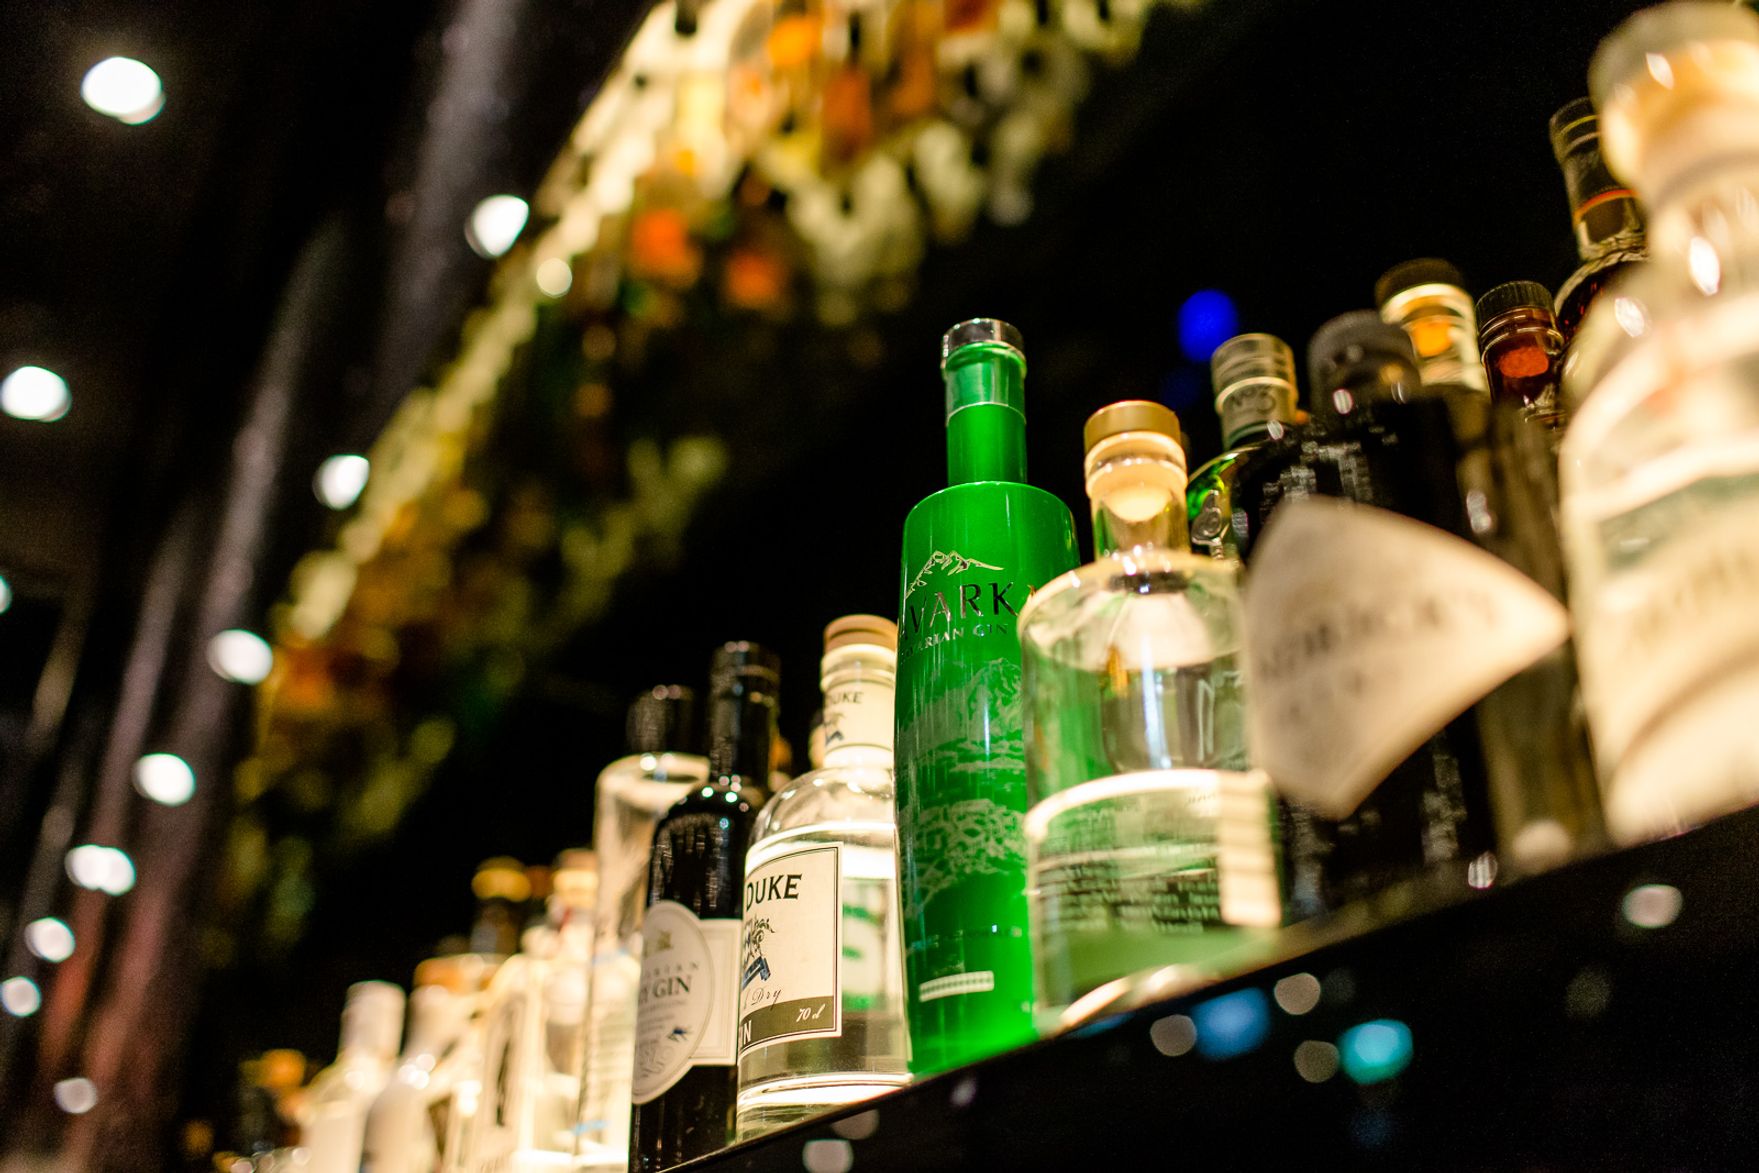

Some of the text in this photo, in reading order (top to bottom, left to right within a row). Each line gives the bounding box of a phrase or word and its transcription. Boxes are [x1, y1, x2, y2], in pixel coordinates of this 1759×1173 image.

[905, 582, 1036, 638] VARK
[746, 874, 803, 912] DUKE
[653, 975, 693, 998] GIN
[751, 987, 782, 1012] Dry
[796, 1007, 812, 1023] 70
